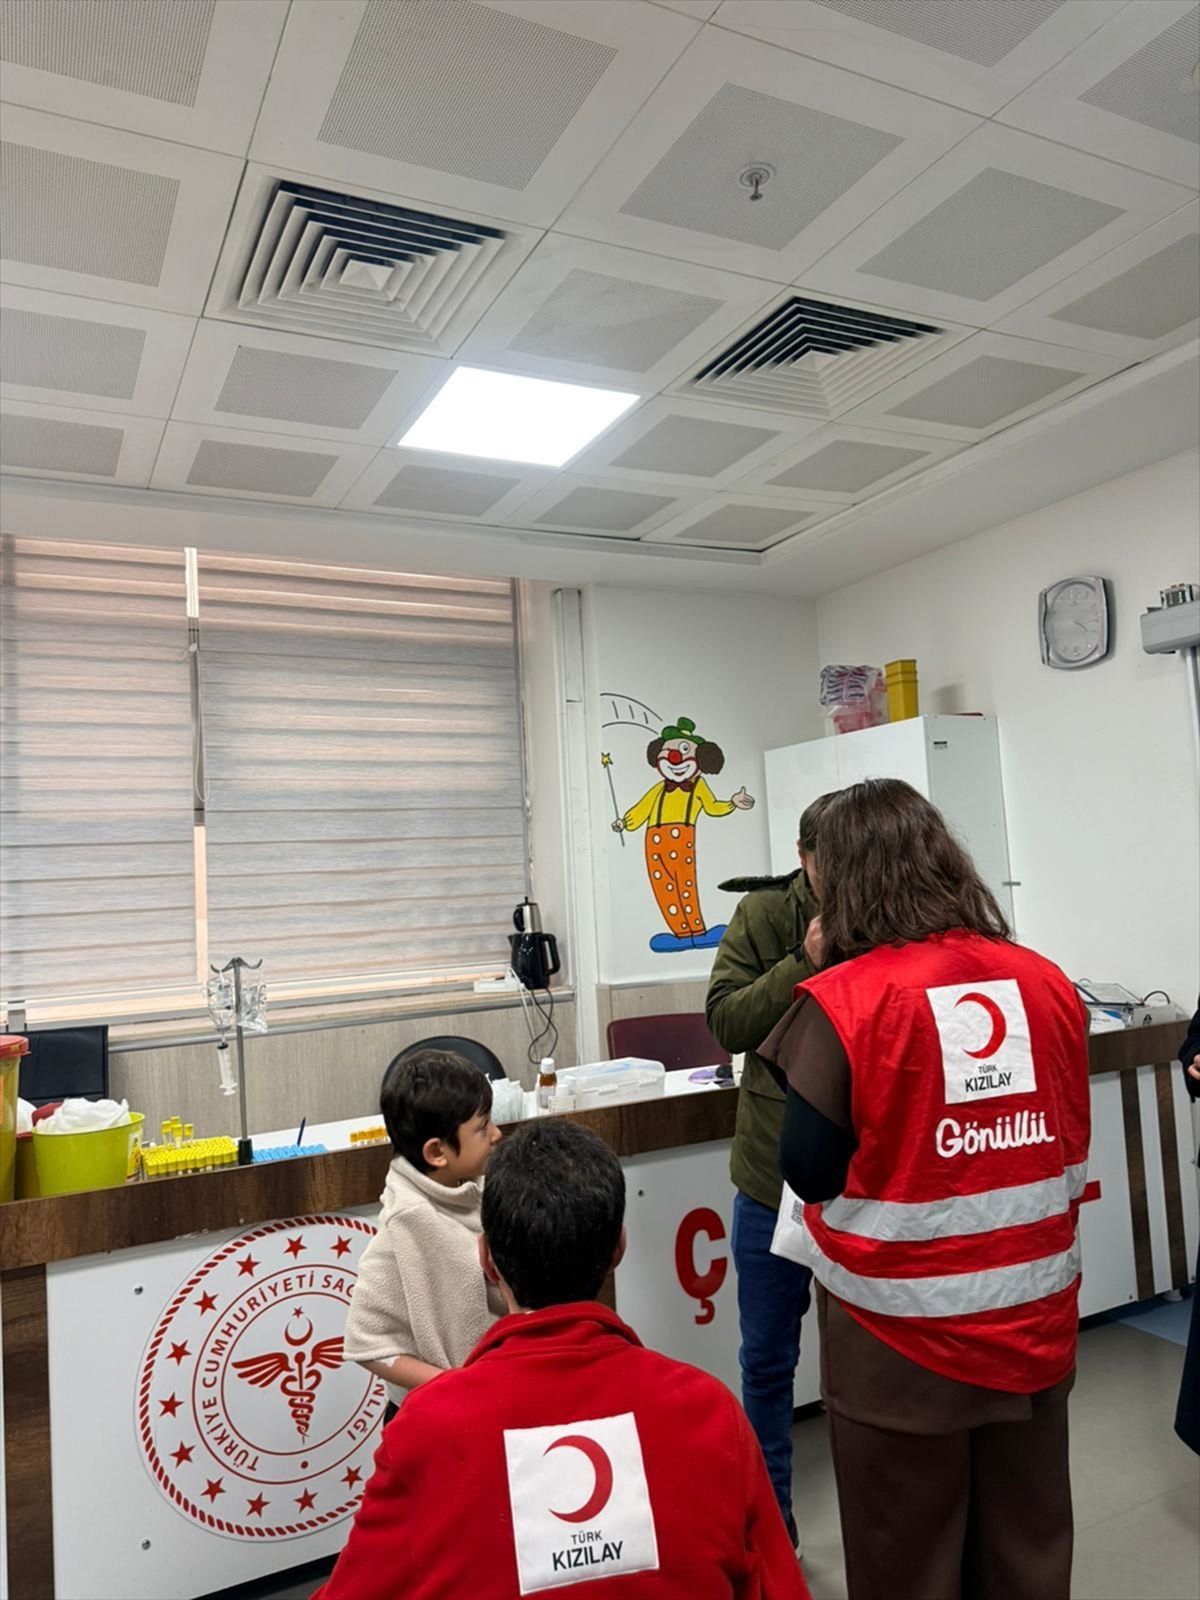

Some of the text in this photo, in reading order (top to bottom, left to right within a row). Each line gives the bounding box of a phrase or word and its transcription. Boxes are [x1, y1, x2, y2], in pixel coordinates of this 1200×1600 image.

[965, 1072, 1012, 1093] KIZILAY
[978, 1064, 998, 1074] TÜRK
[936, 1110, 1055, 1158] Gönüllü
[202, 1270, 314, 1388] CUMHURİYETİ
[202, 1396, 259, 1471] TÜRKİYE
[571, 1530, 603, 1545] TÜRK
[552, 1541, 623, 1571] KIZILAY
